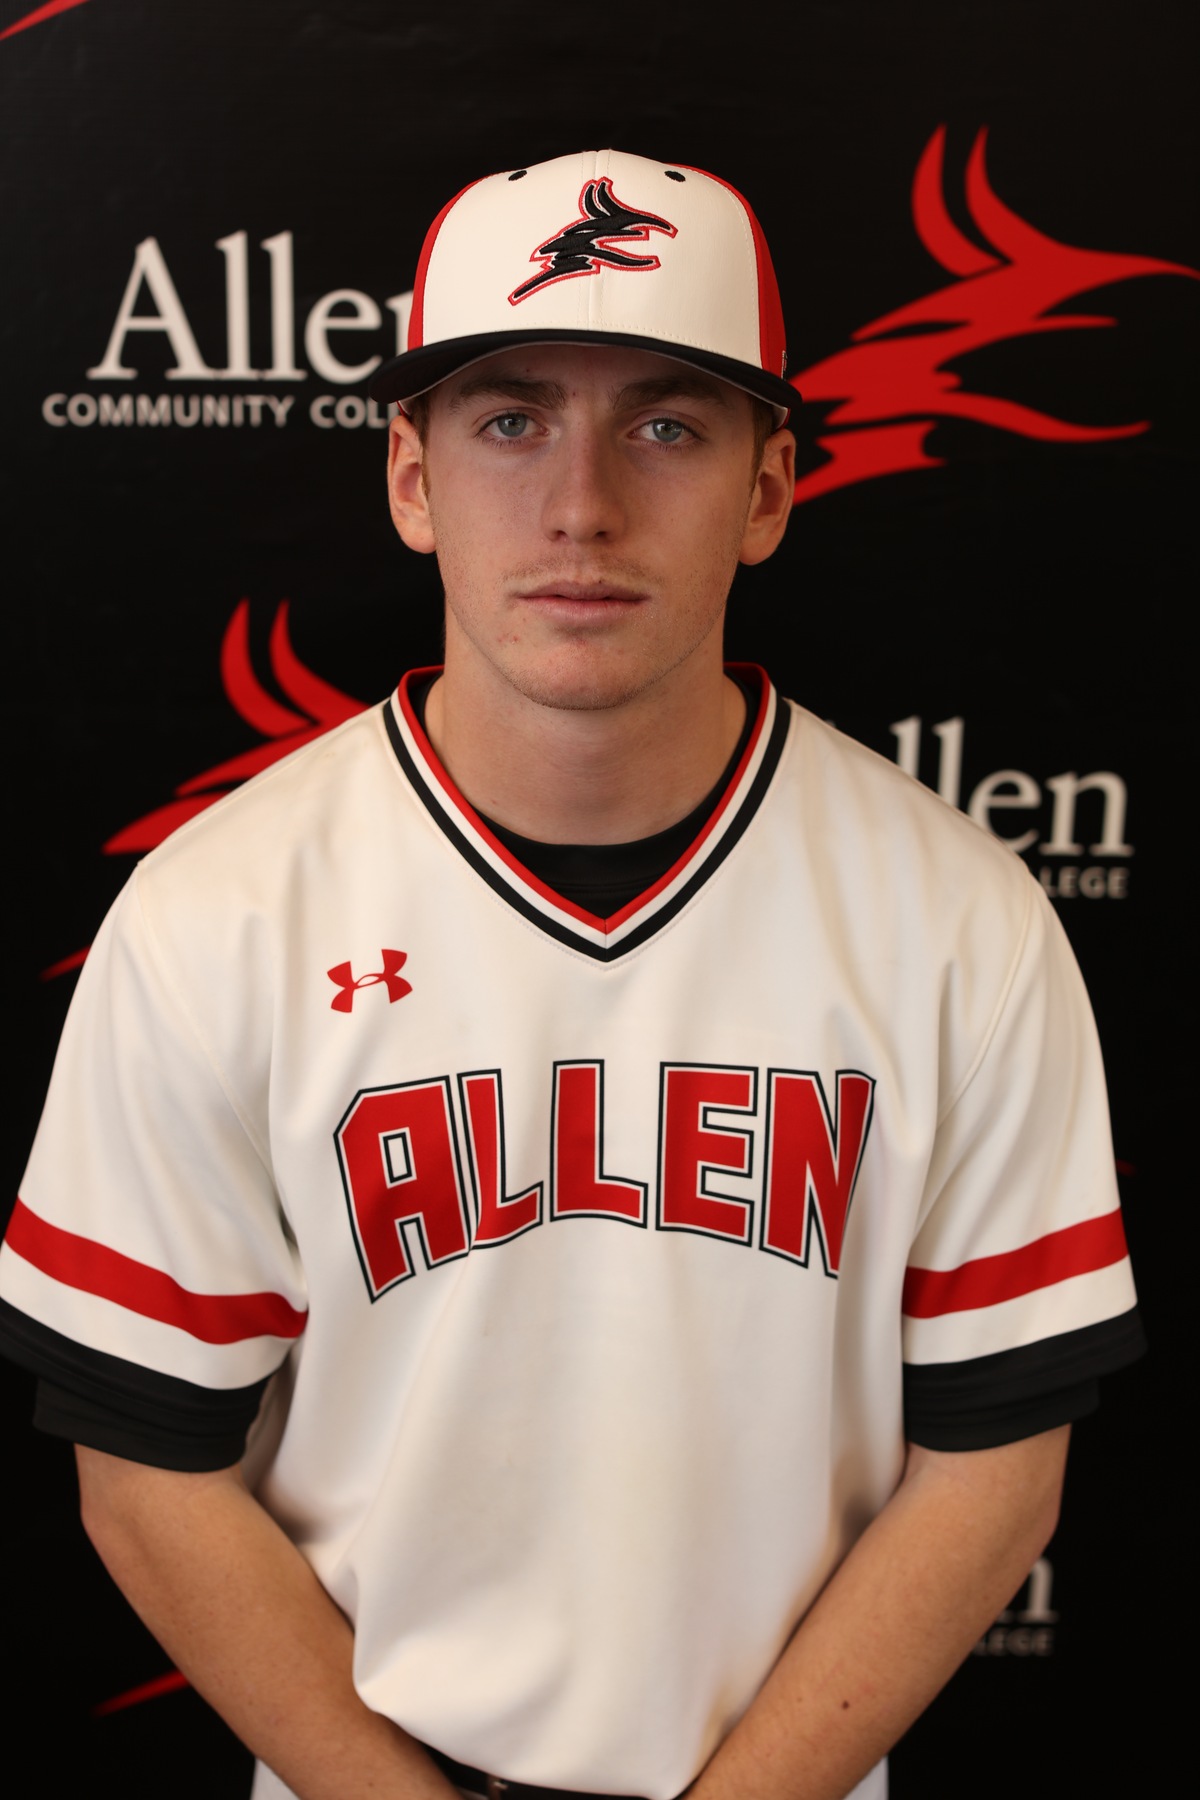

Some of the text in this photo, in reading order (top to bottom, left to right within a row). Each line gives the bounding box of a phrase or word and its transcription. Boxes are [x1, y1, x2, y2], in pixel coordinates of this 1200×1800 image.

[42, 393, 400, 429] COMMUNITY COL
[333, 1058, 877, 1304] ALLEN
